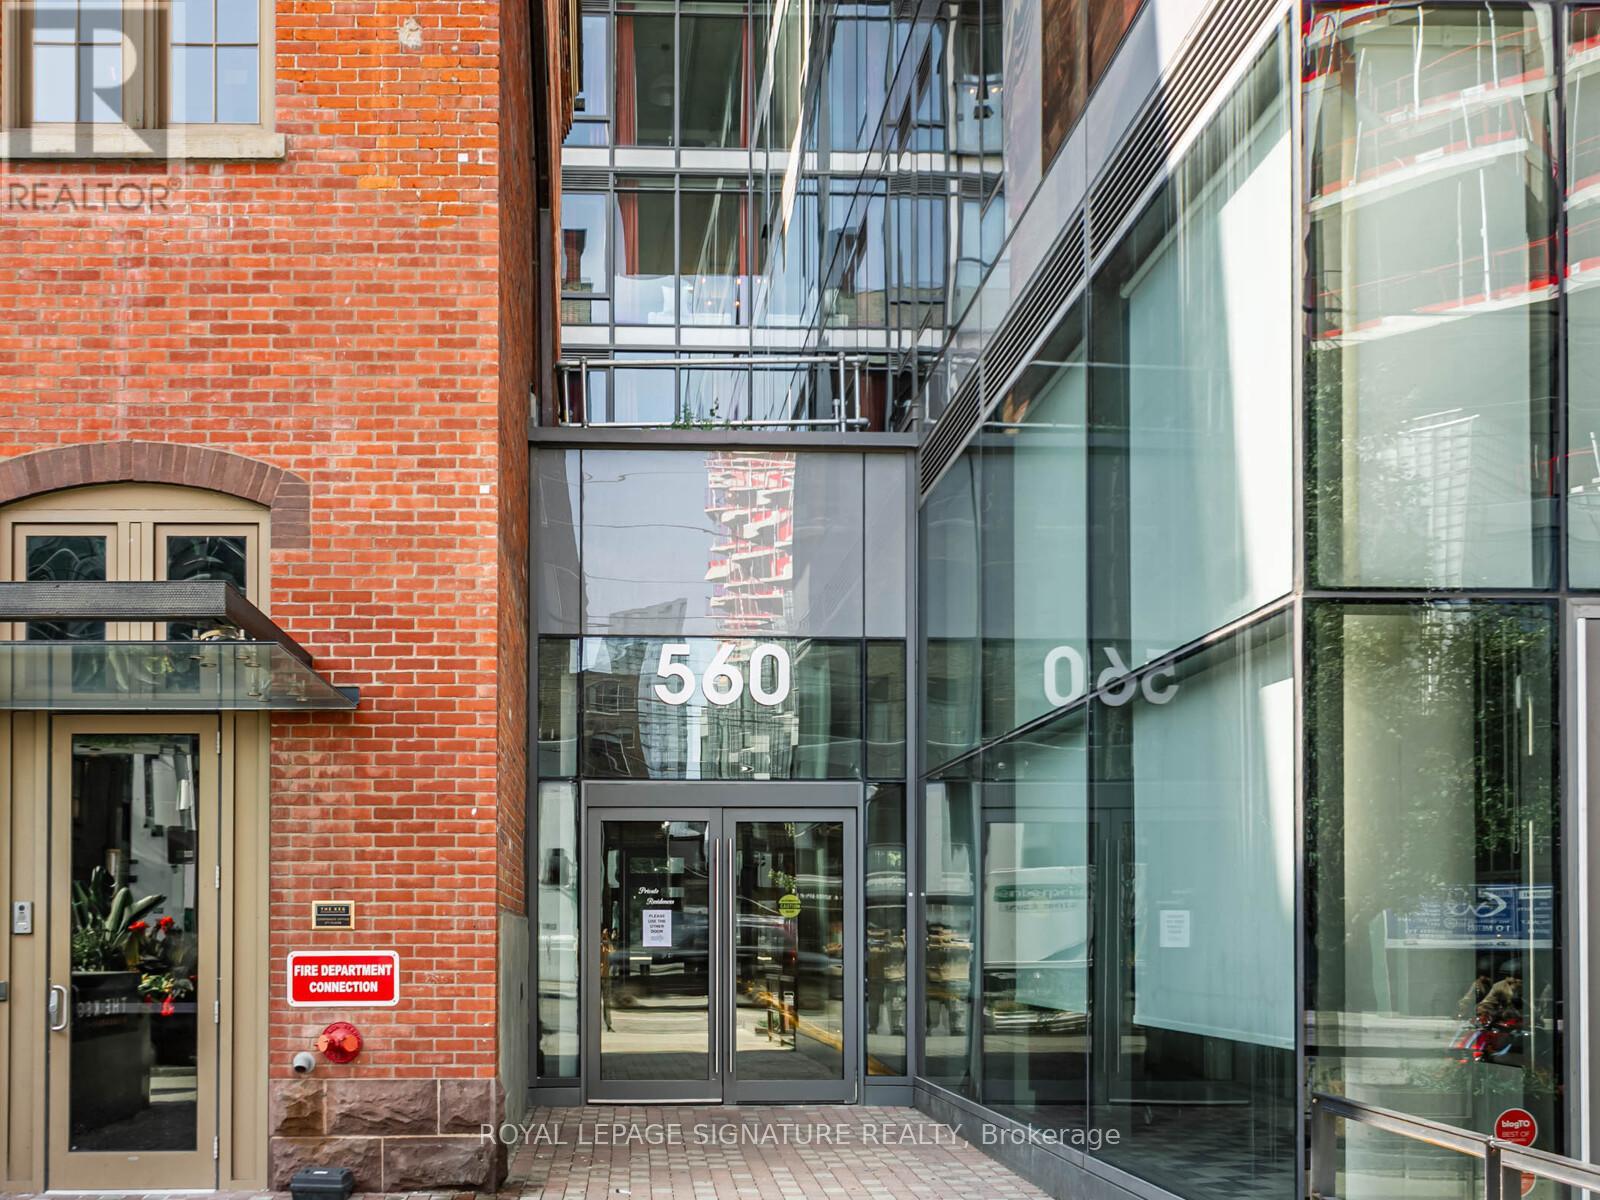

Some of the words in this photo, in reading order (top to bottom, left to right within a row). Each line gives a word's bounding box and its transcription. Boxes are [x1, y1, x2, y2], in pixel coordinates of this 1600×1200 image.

[653, 642, 792, 707] 560
[638, 886, 659, 895] Private
[294, 964, 319, 977] FIRE
[321, 964, 393, 977] DEPARTMENT
[309, 981, 378, 993] CONNECTION
[1501, 1119, 1531, 1129] blogTO
[1502, 1130, 1519, 1138] BEST
